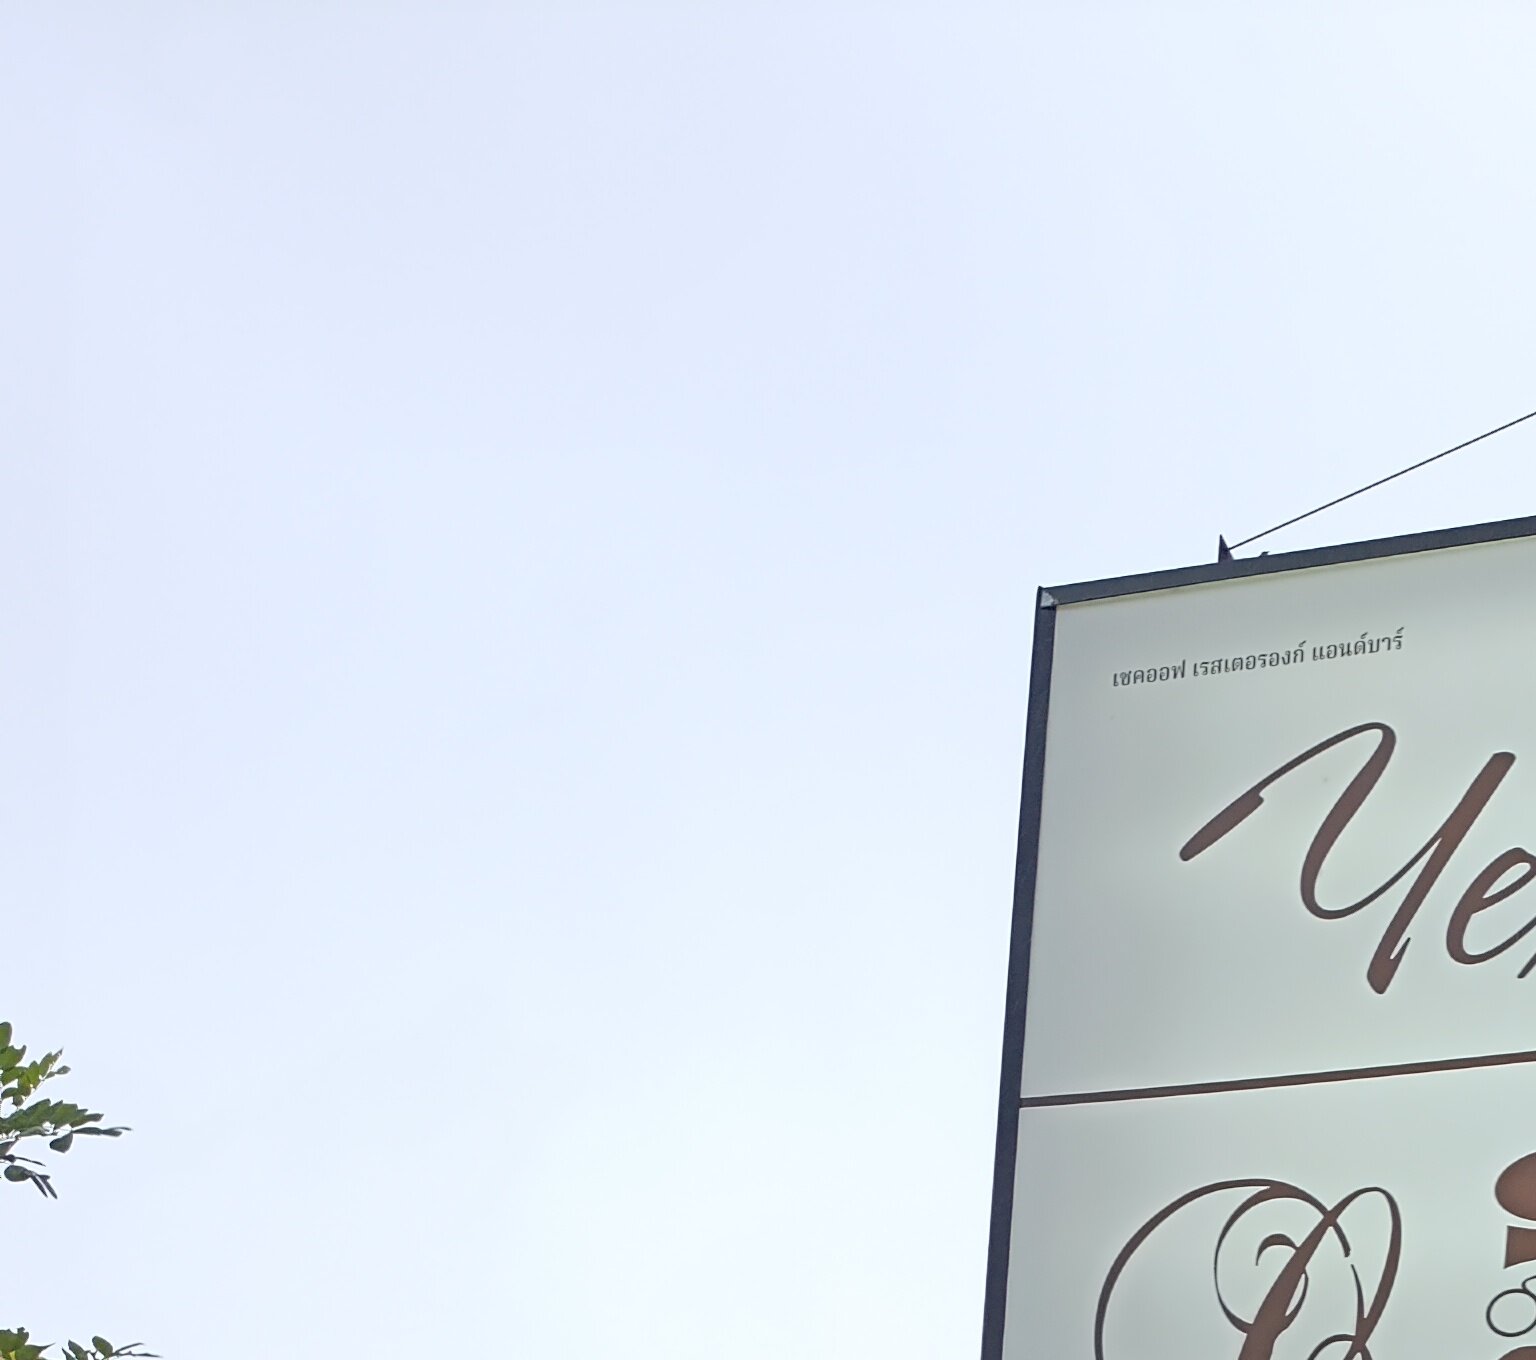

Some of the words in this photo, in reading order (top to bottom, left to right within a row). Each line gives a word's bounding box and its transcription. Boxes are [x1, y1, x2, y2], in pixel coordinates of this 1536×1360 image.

[1112, 660, 1187, 687] เชคออฟ
[1193, 640, 1307, 677] เรสเตอรองก์
[1312, 627, 1405, 661] แอนด์บาร์
